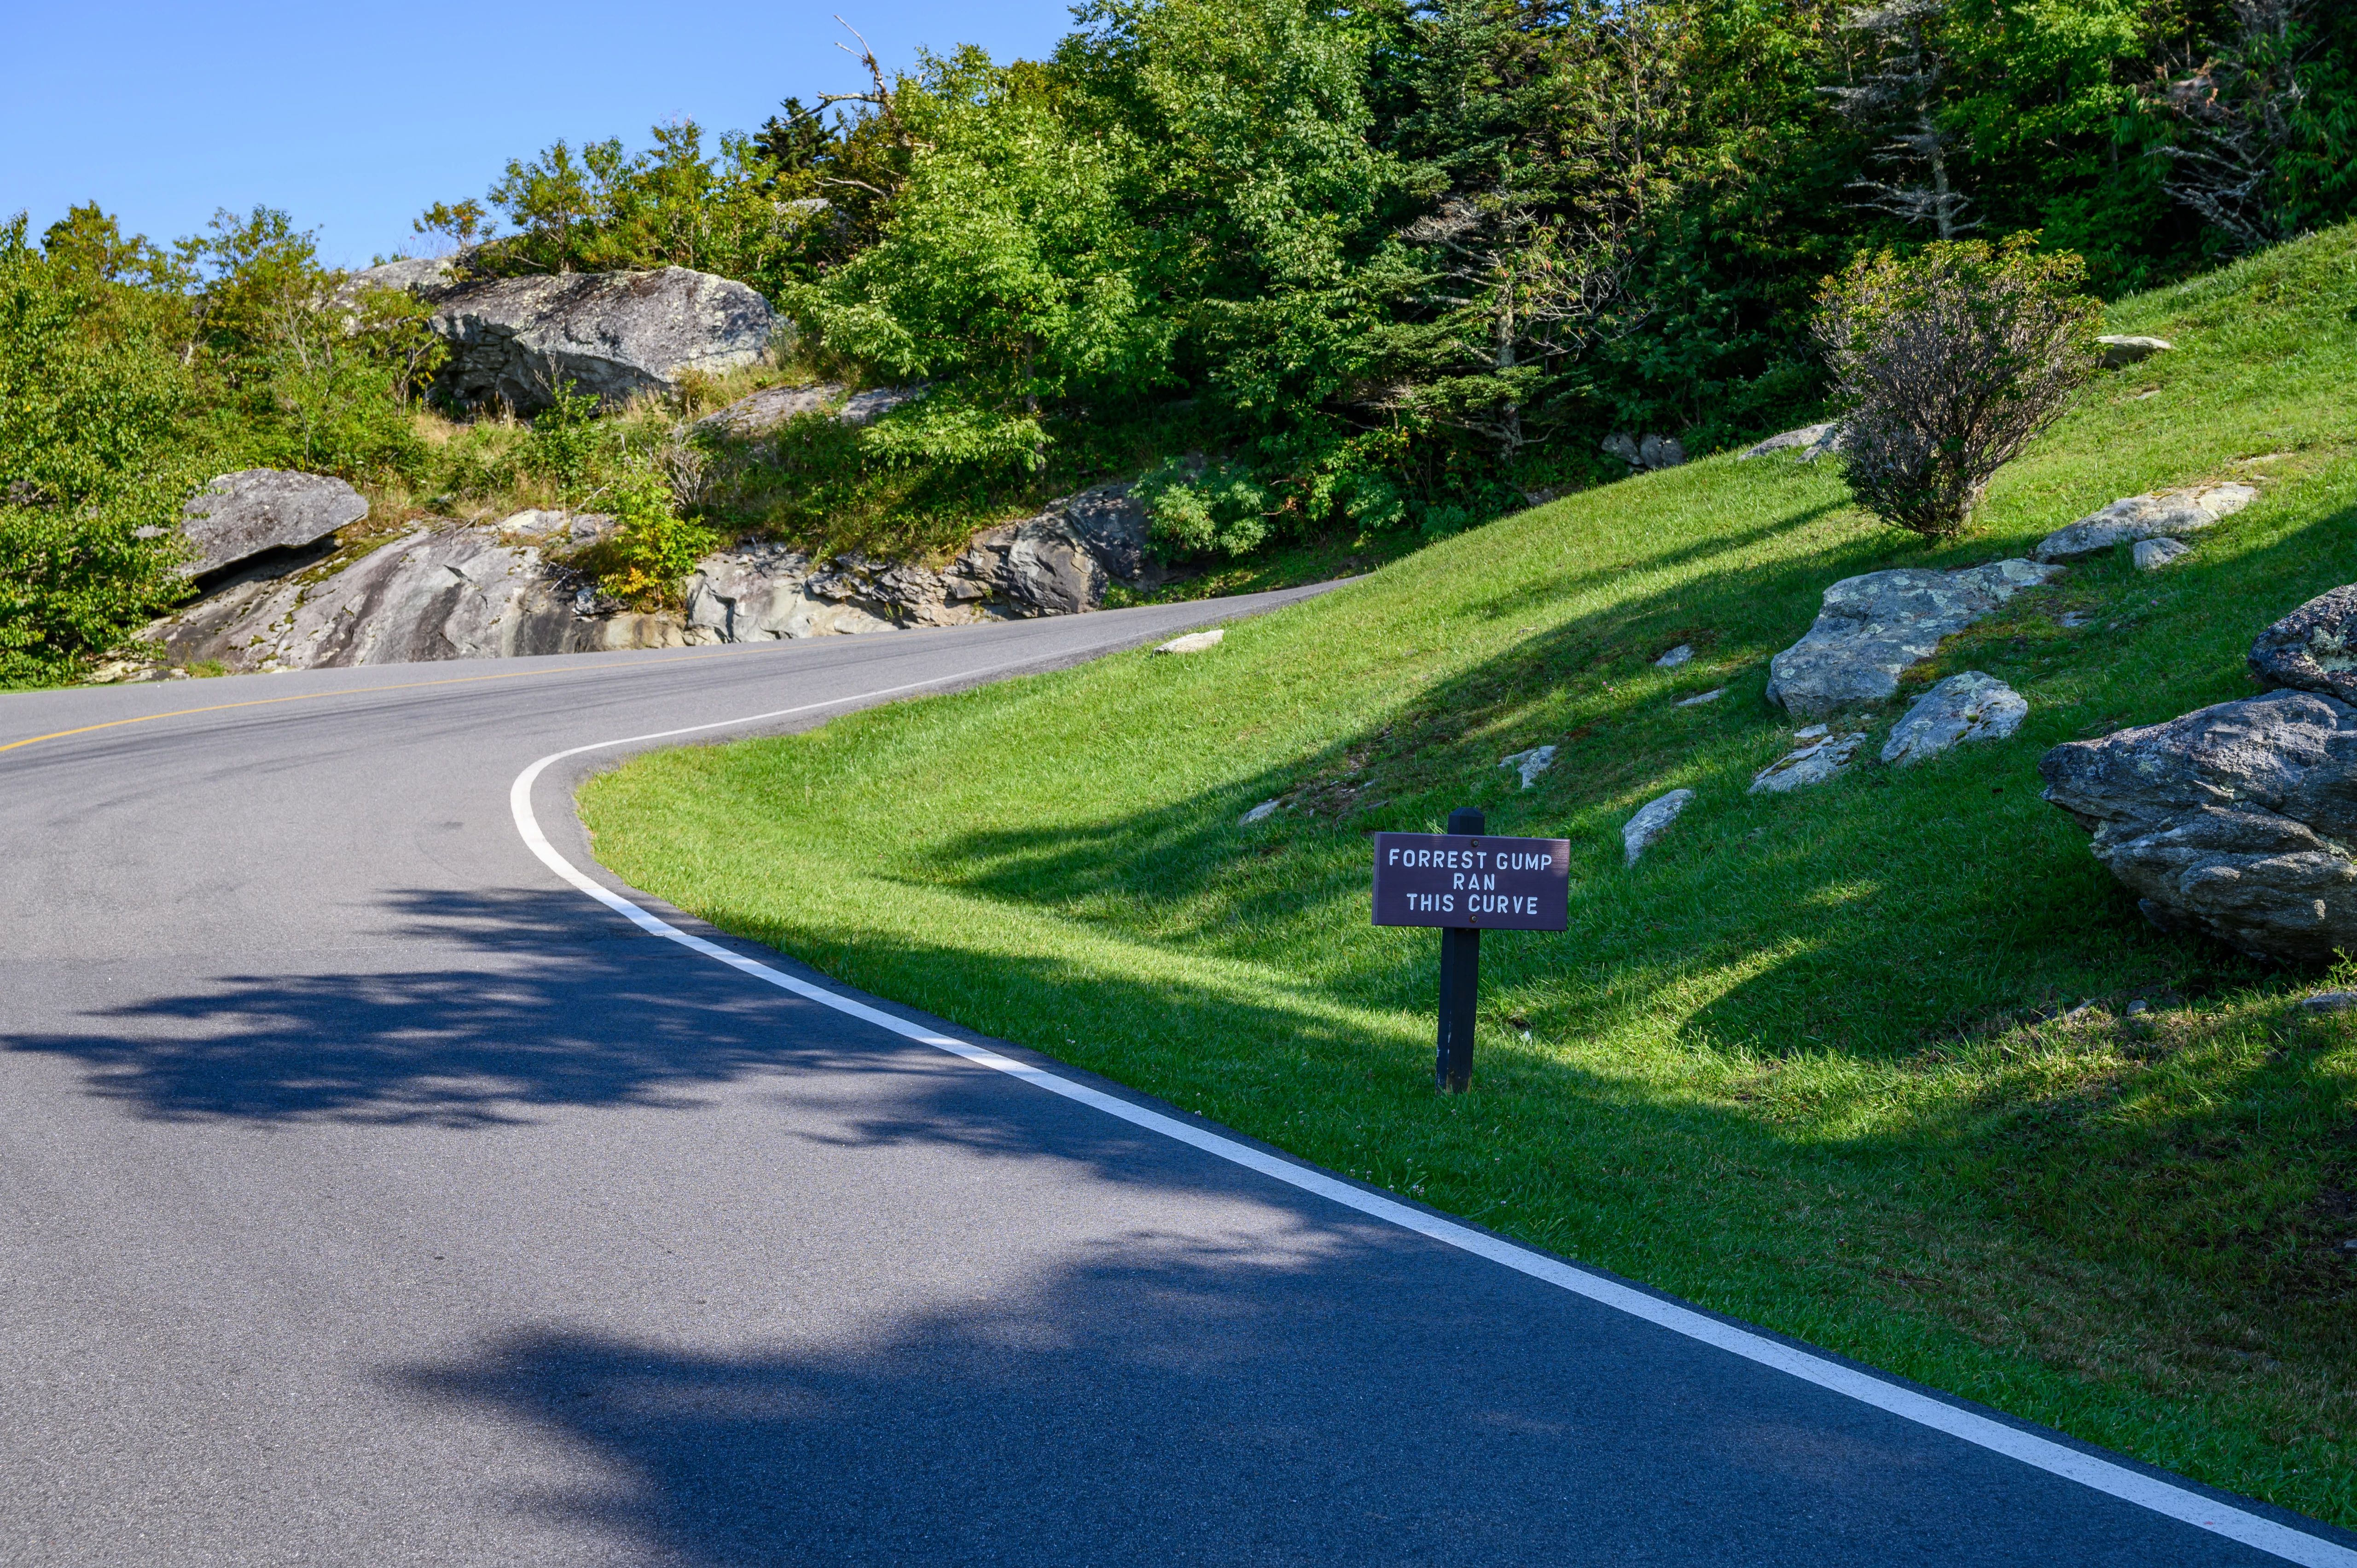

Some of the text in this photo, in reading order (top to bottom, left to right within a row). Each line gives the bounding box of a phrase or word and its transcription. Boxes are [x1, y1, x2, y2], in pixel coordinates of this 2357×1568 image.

[1389, 848, 1552, 871] FORREST GUMP
[1453, 872, 1495, 891] RAN
[1406, 893, 1538, 915] THIS CURVE
